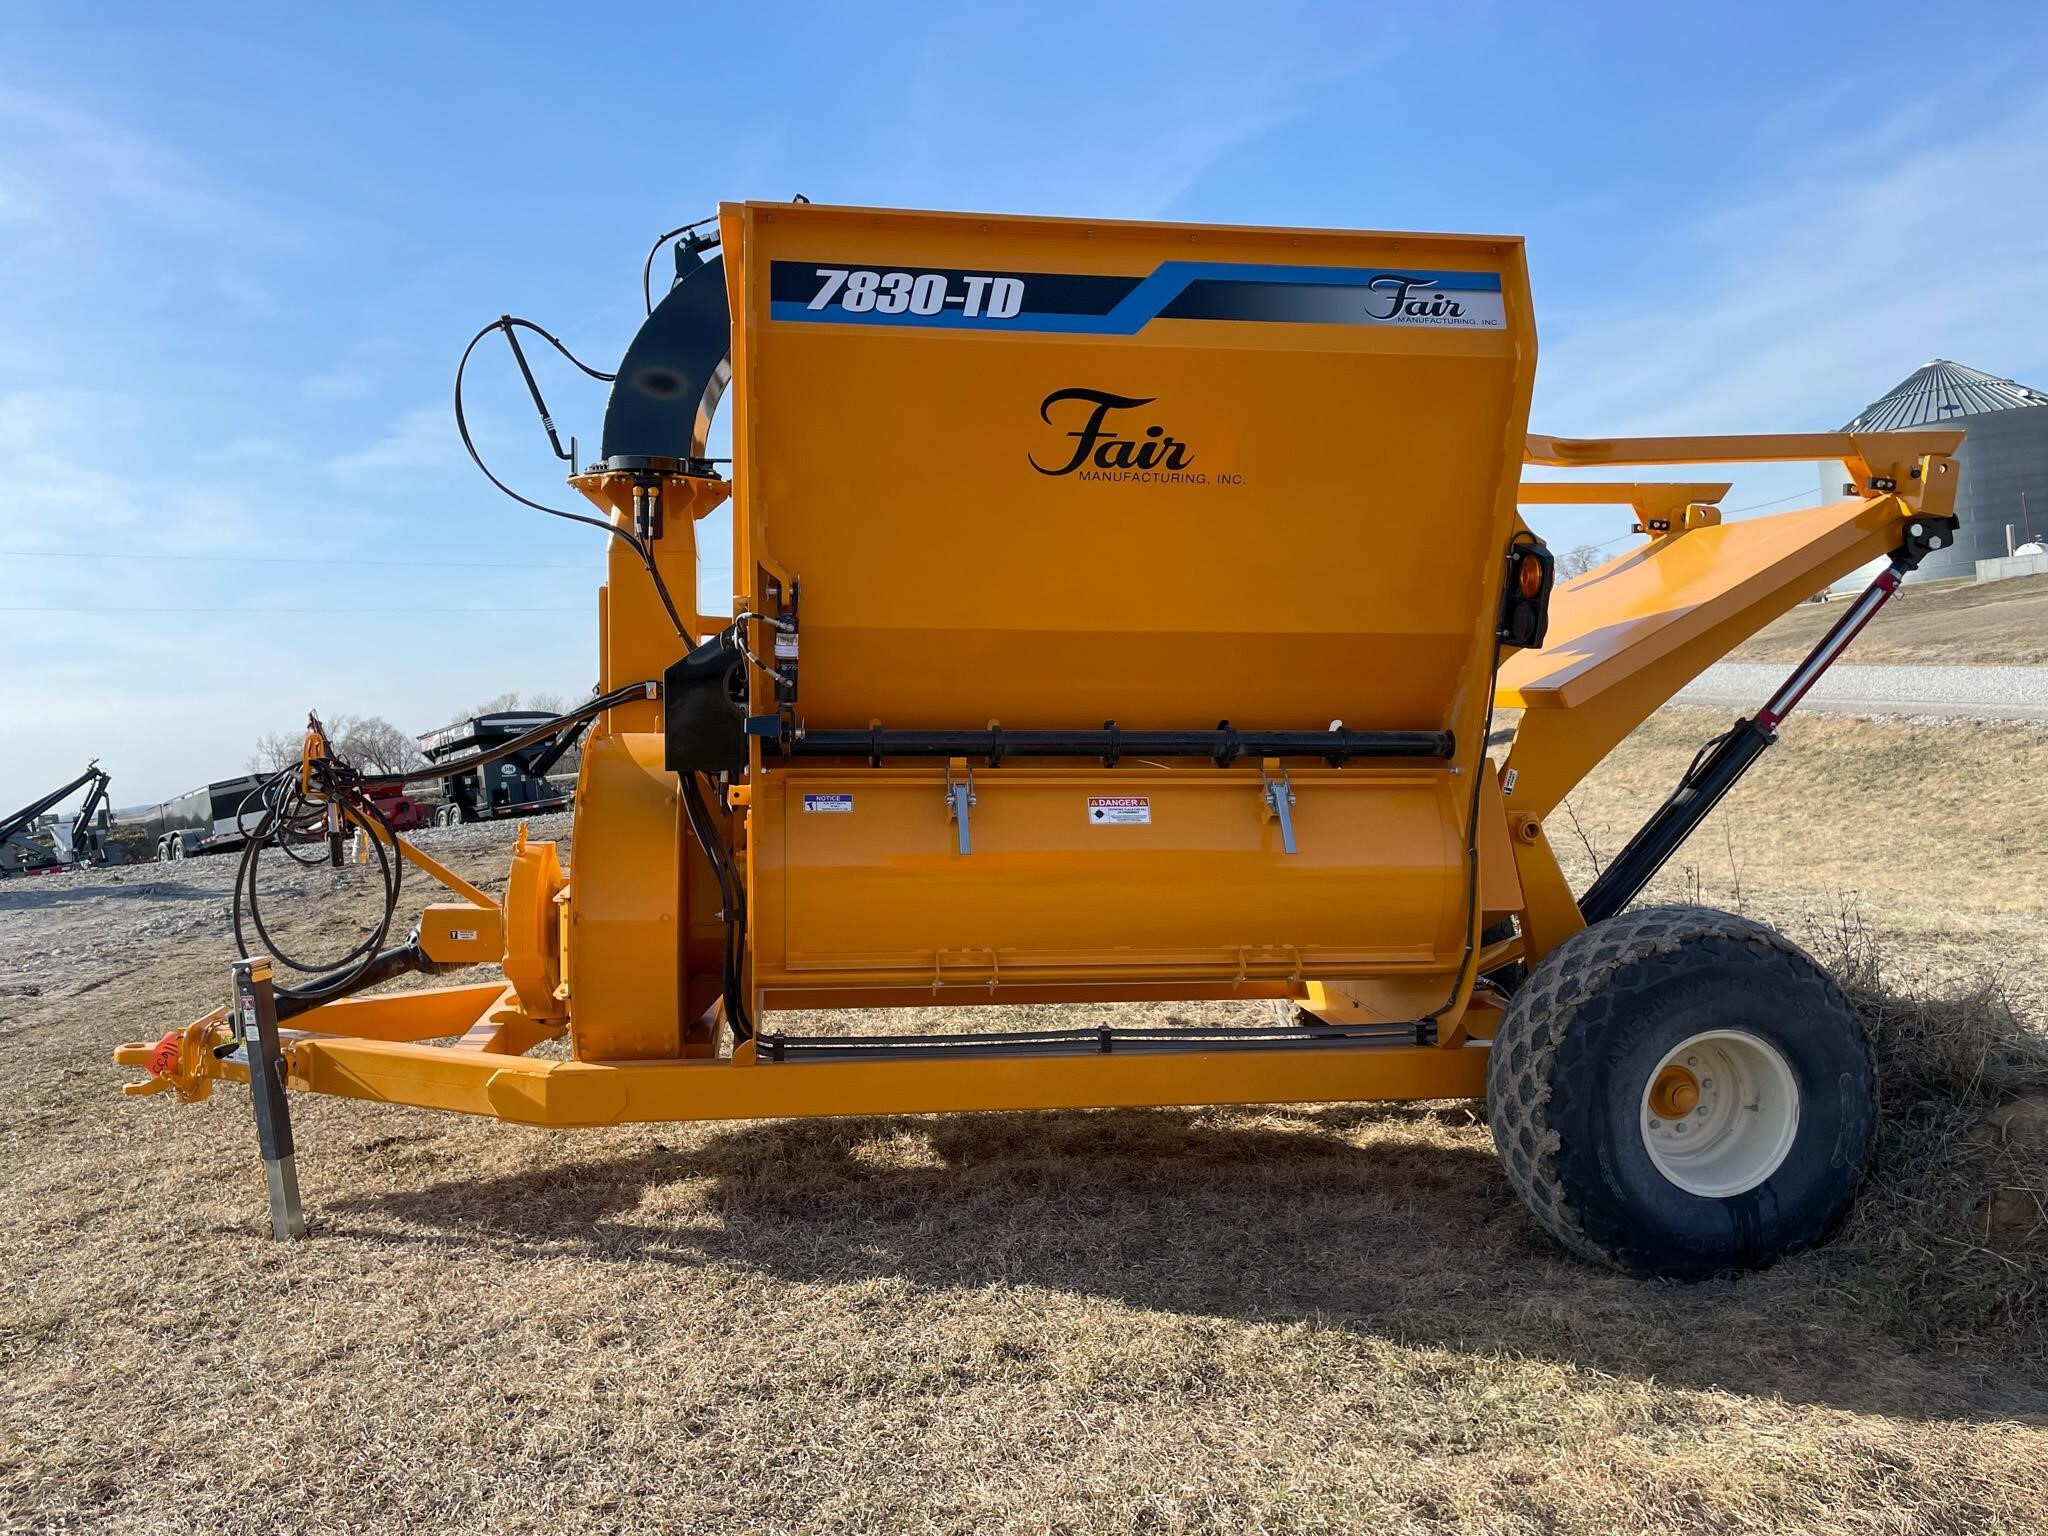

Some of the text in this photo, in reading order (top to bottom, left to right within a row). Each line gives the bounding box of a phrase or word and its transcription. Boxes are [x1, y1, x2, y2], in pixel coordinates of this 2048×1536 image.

[806, 268, 1025, 319] 7830-TD
[1363, 273, 1468, 321] Fair
[1397, 316, 1480, 327] MANUFACTURING,
[1027, 387, 1196, 476] Fair
[1078, 470, 1247, 486] MANUFACTURING, INC.
[1098, 799, 1139, 807] DANGER
